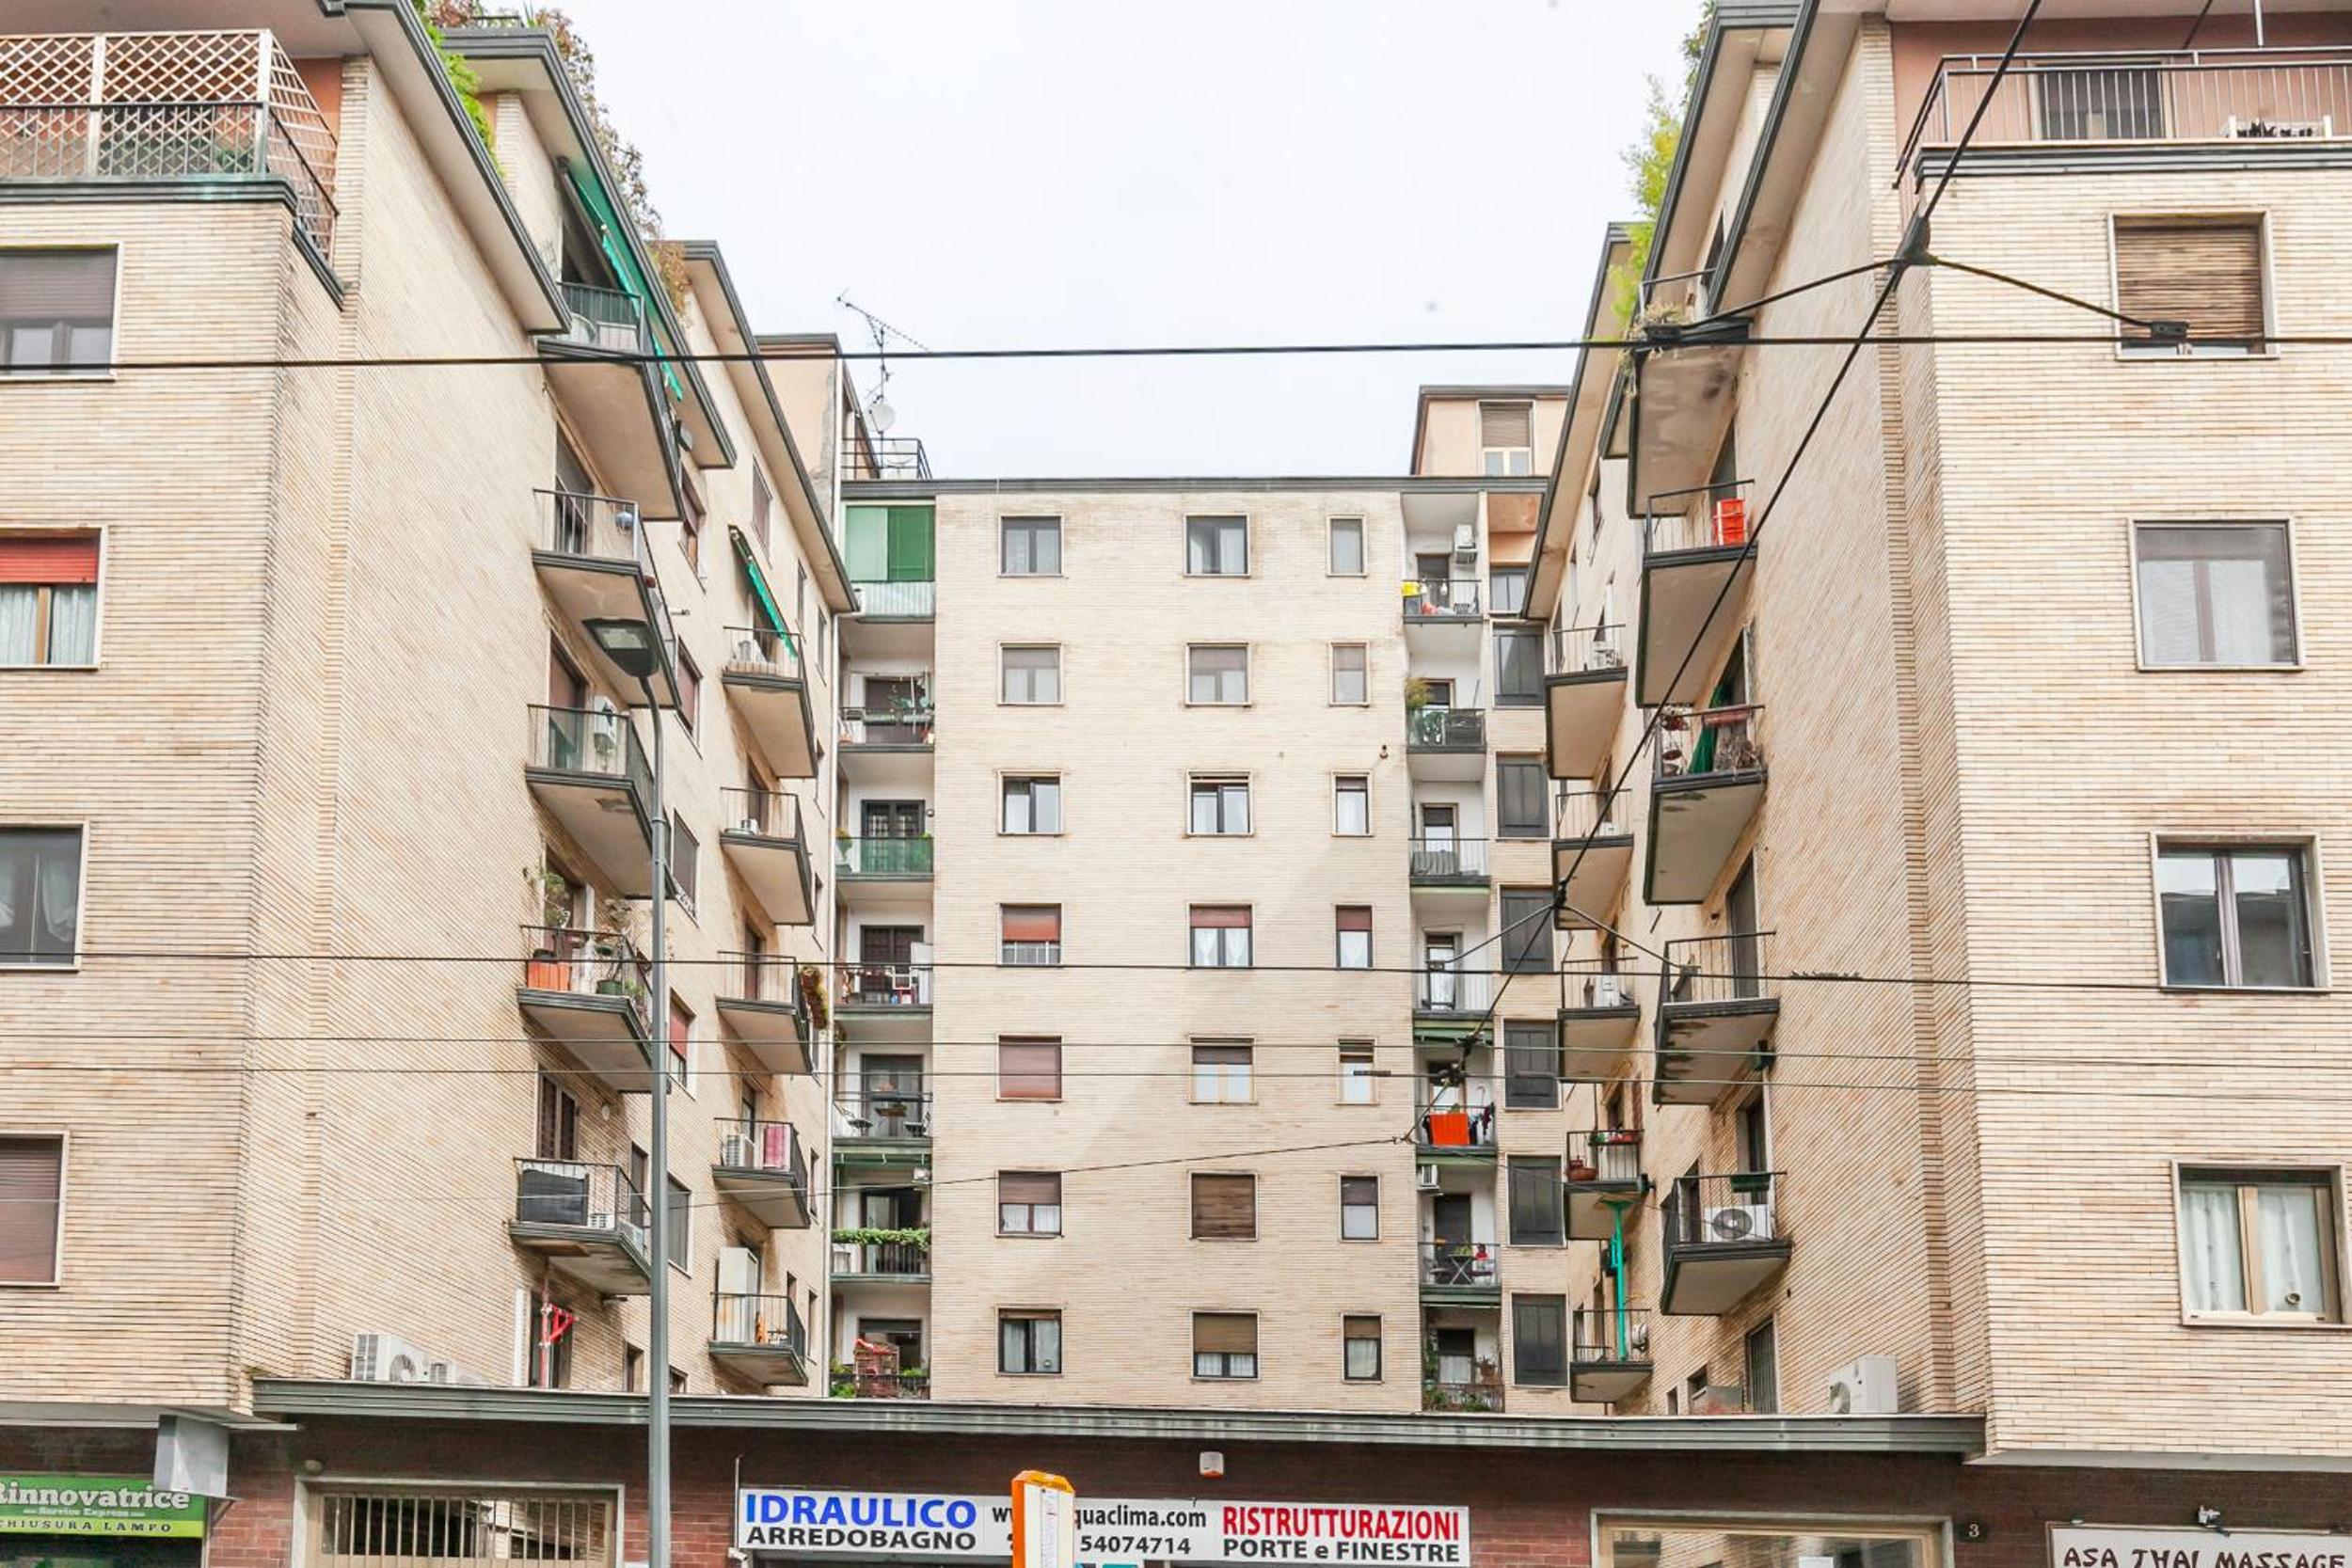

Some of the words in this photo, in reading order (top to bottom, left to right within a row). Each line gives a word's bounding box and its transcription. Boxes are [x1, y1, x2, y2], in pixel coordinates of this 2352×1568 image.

[746, 1495, 977, 1528] IDRAULICO
[103, 1522, 171, 1532] LAMPO
[1223, 1507, 1459, 1541] RISTRUTTURAZIONI
[1969, 1524, 1979, 1537] 3
[747, 1527, 976, 1550] ARREDOBAGNO
[1080, 1535, 1191, 1554] 54074714
[1223, 1539, 1308, 1559] PORTE
[1314, 1544, 1328, 1559] e
[1336, 1541, 1460, 1562] FINESTRE
[2063, 1547, 2119, 1568] ASA
[2132, 1549, 2201, 1568] THAI
[2215, 1552, 2345, 1568] MASSAGE
